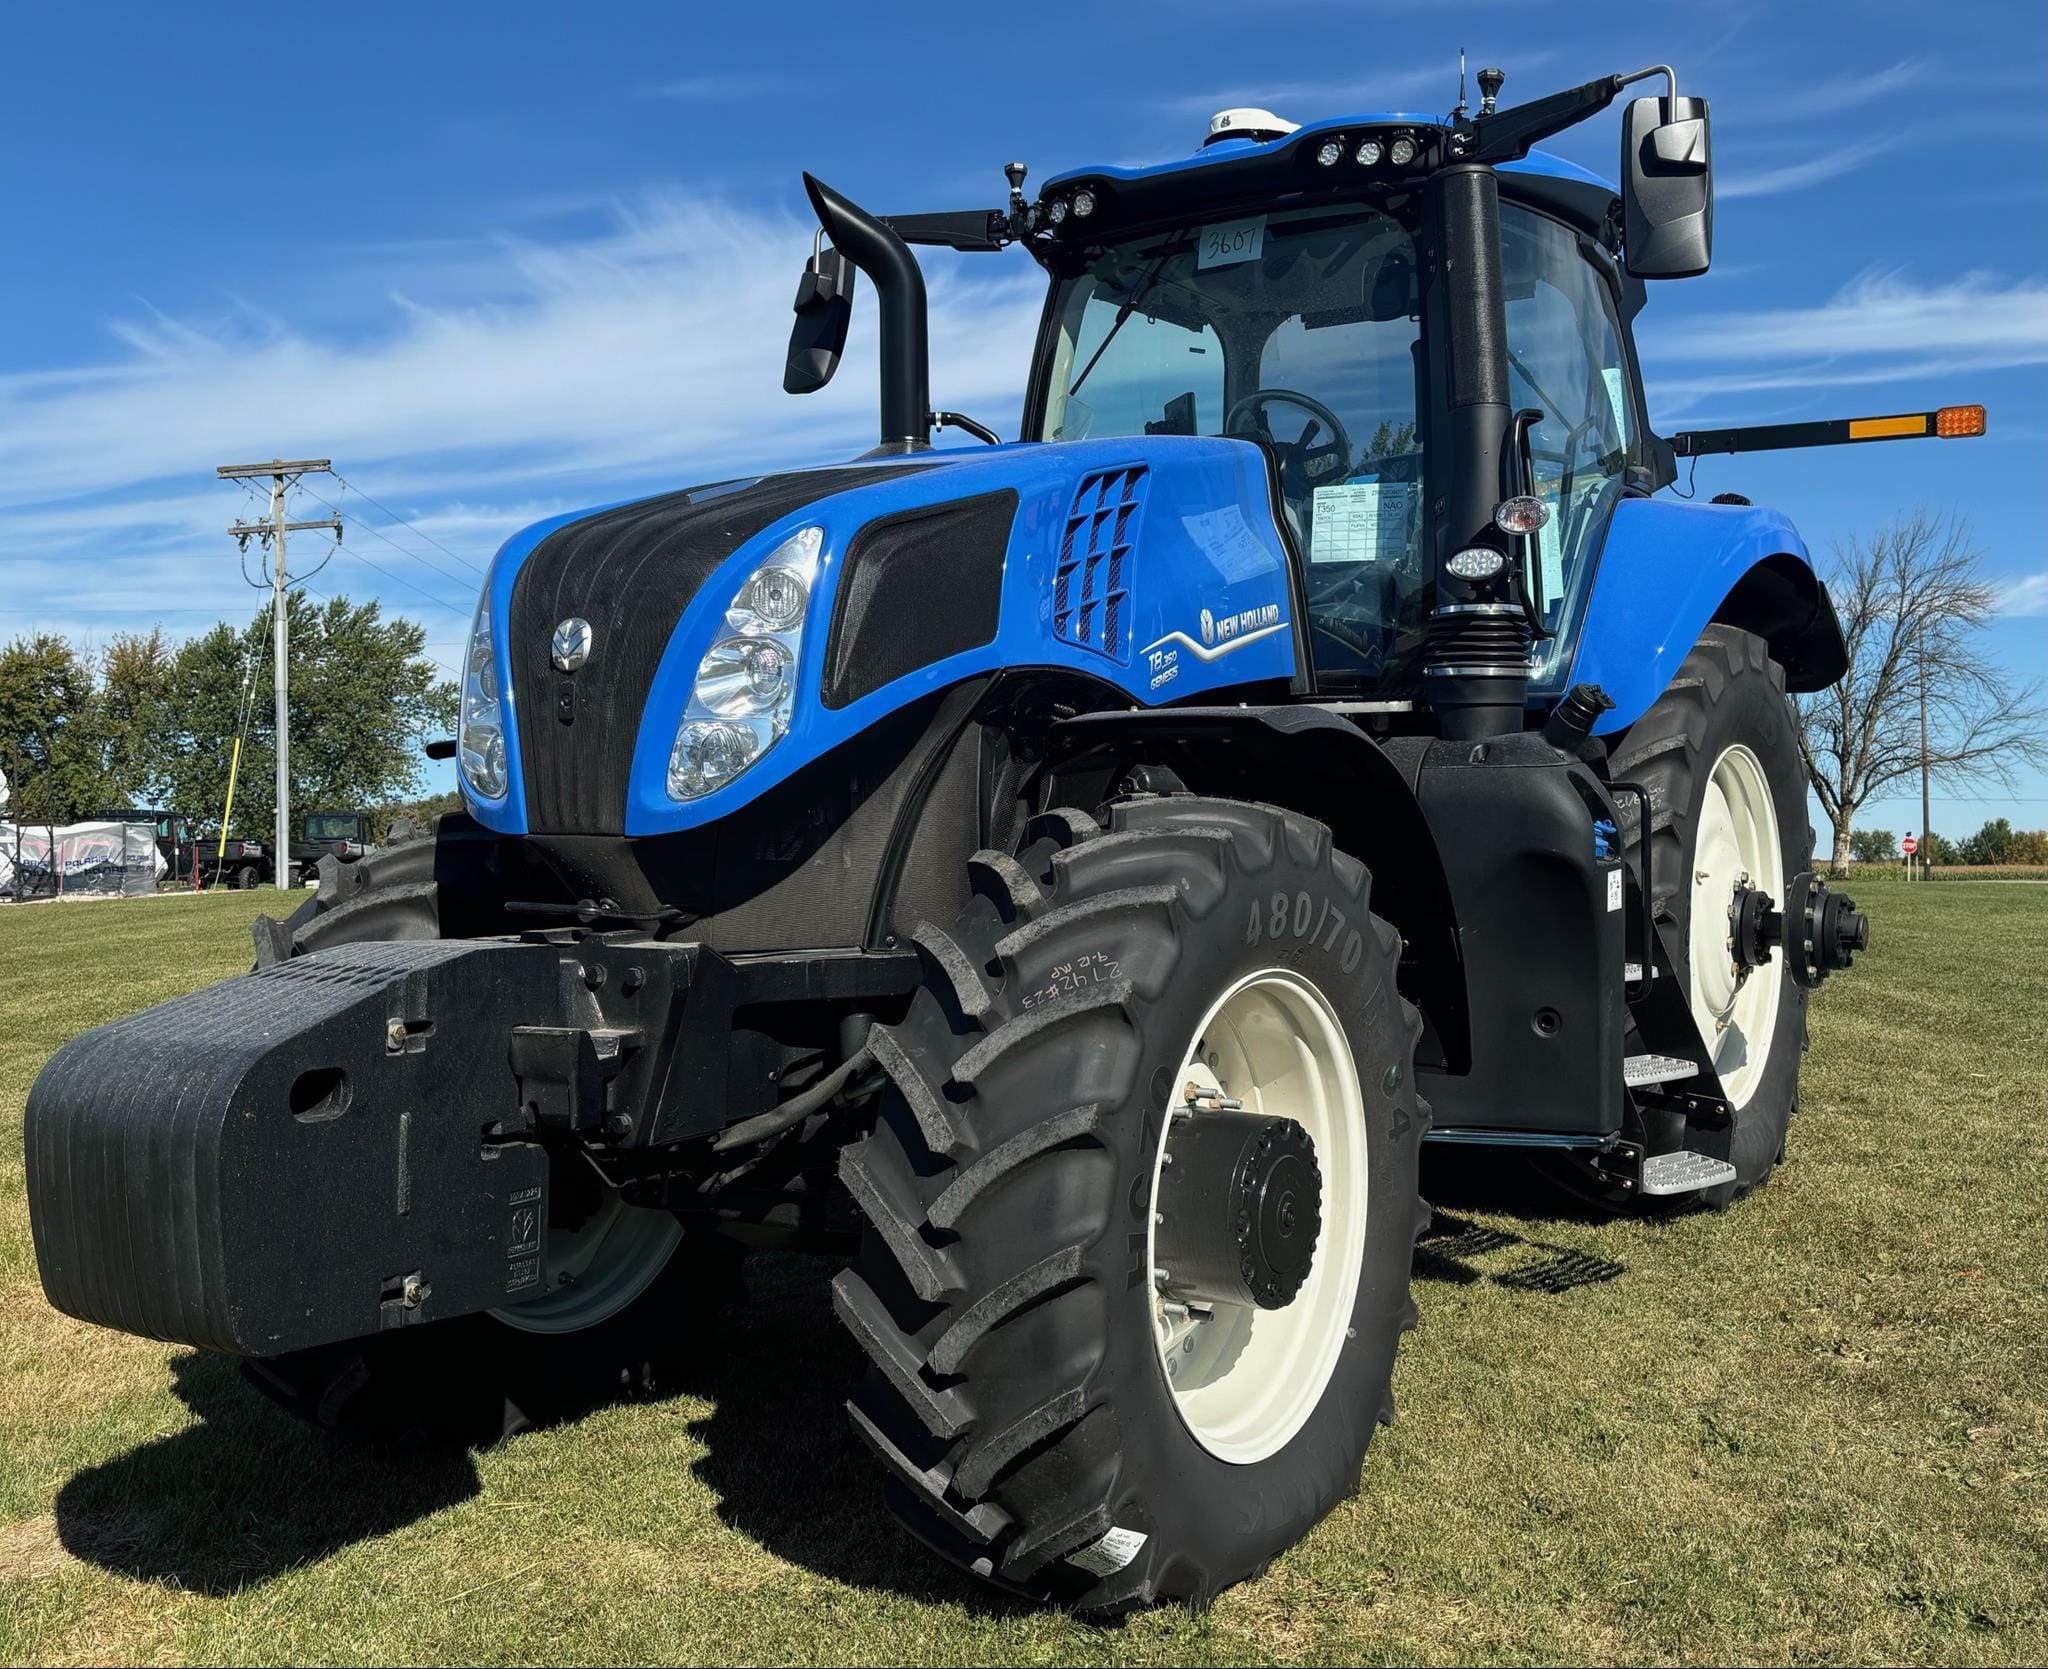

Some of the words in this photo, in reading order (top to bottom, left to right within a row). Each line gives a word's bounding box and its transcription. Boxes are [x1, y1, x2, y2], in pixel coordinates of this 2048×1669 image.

[1207, 227, 1256, 260] 3607
[1216, 614, 1238, 641] NEW
[1240, 604, 1279, 632] HOLLAND
[65, 855, 109, 868] POLARIS
[1245, 891, 1363, 975] 480/70
